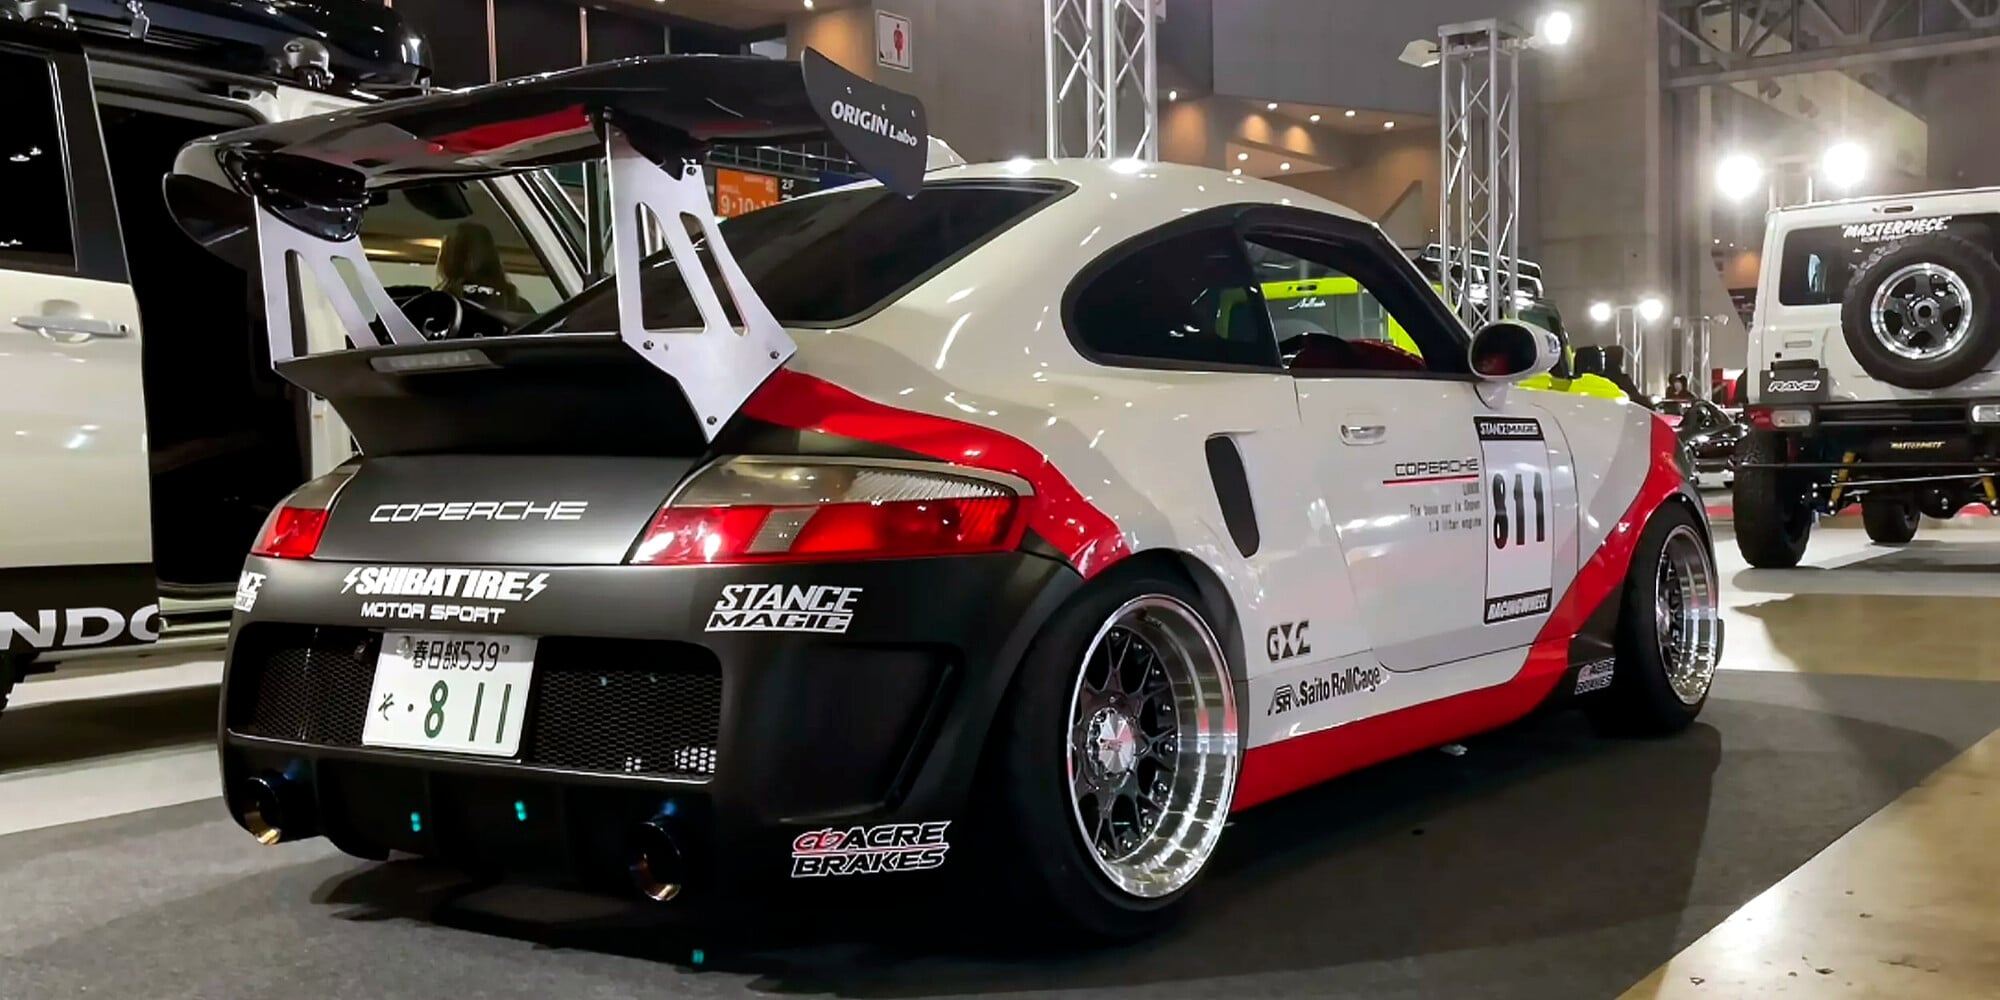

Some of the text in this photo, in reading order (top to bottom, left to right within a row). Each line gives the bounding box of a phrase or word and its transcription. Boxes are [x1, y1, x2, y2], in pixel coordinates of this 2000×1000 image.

[831, 100, 918, 147] ORIGIN Labo
[1395, 458, 1479, 477] COPERCHE
[370, 501, 588, 523] COPERCHE
[1493, 472, 1545, 550] 811
[356, 567, 529, 601] SHIBATIRE
[714, 584, 863, 613] STANCE
[361, 602, 506, 624] MOTOR SPORT
[707, 612, 850, 632] MAGIC
[1299, 677, 1330, 706] Saito
[837, 820, 952, 850] ACRE
[791, 847, 949, 878] BRAKES
